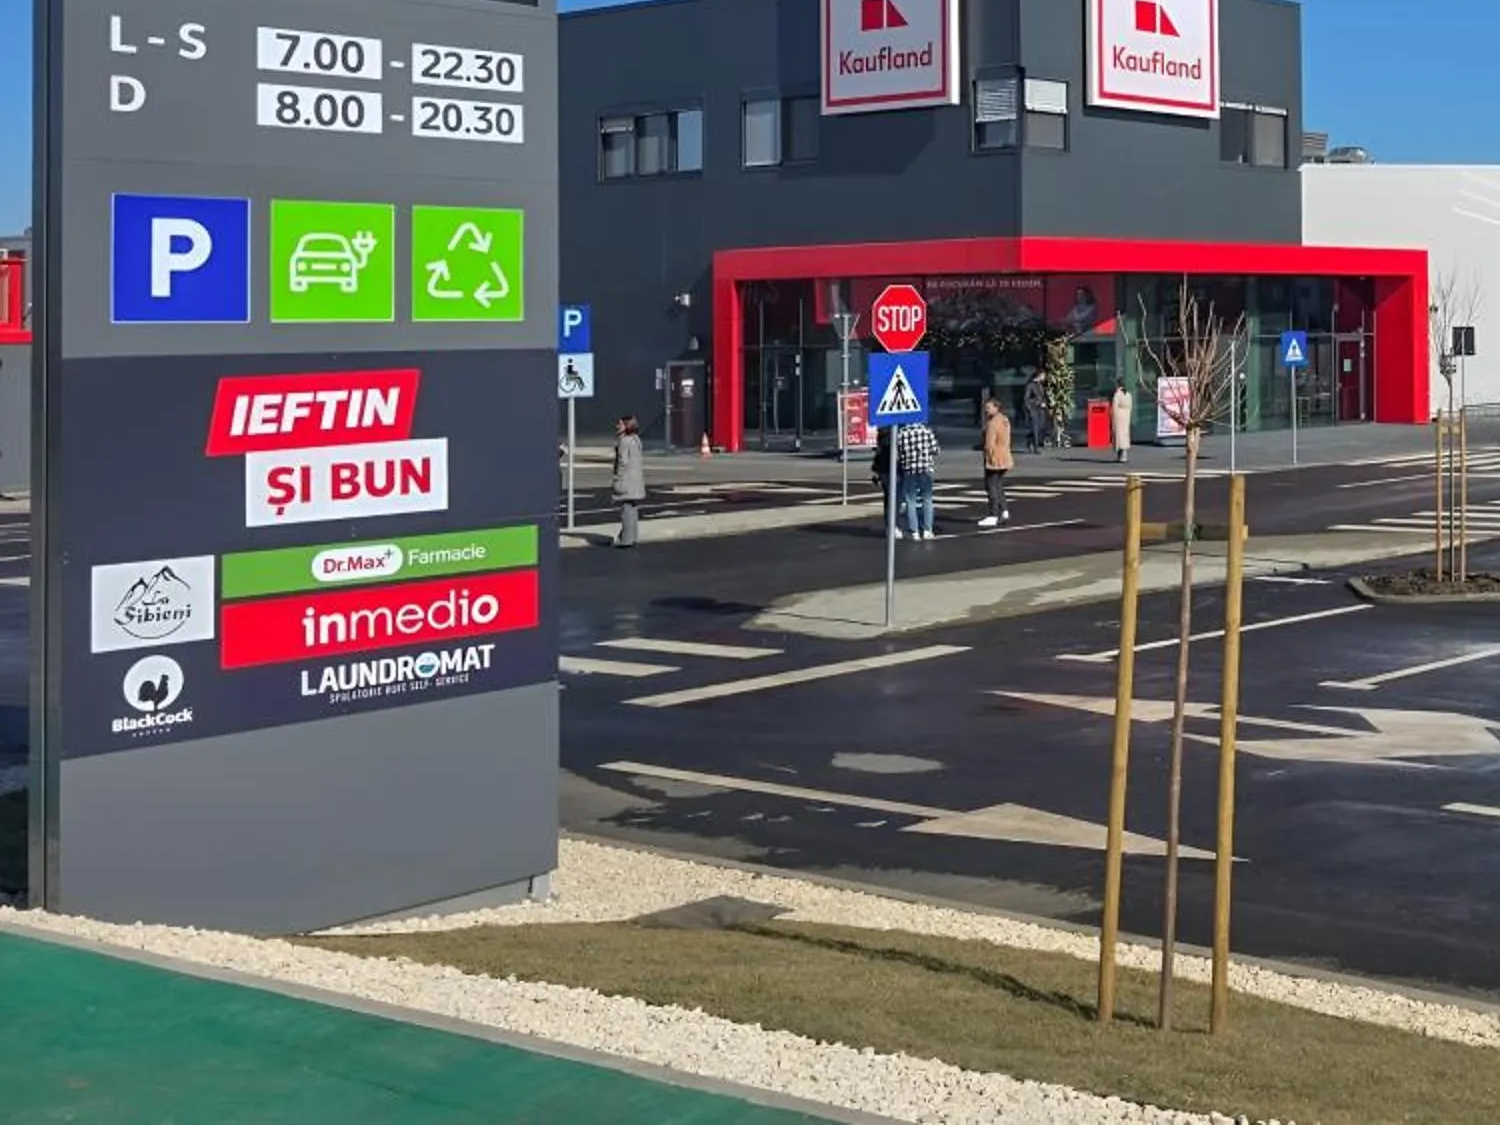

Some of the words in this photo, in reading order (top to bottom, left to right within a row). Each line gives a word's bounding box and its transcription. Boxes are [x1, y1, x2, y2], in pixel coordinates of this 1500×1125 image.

[275, 32, 365, 74] 7.00
[420, 48, 517, 87] 22.30
[839, 41, 933, 76] Kaufland
[1112, 44, 1202, 81] Kaufland
[109, 74, 147, 113] D
[275, 90, 365, 129] 8.00
[419, 100, 516, 137] 20.30
[150, 217, 213, 298] P
[563, 309, 583, 338] P
[877, 305, 923, 333] STOP
[229, 386, 400, 437] IEFTIN
[266, 465, 312, 516] ȘI
[330, 457, 432, 501] BUN
[408, 543, 487, 567] Farmacie
[302, 588, 500, 648] inmedio
[300, 644, 496, 697] LAUNDROMAT
[112, 707, 193, 733] BlackCock
